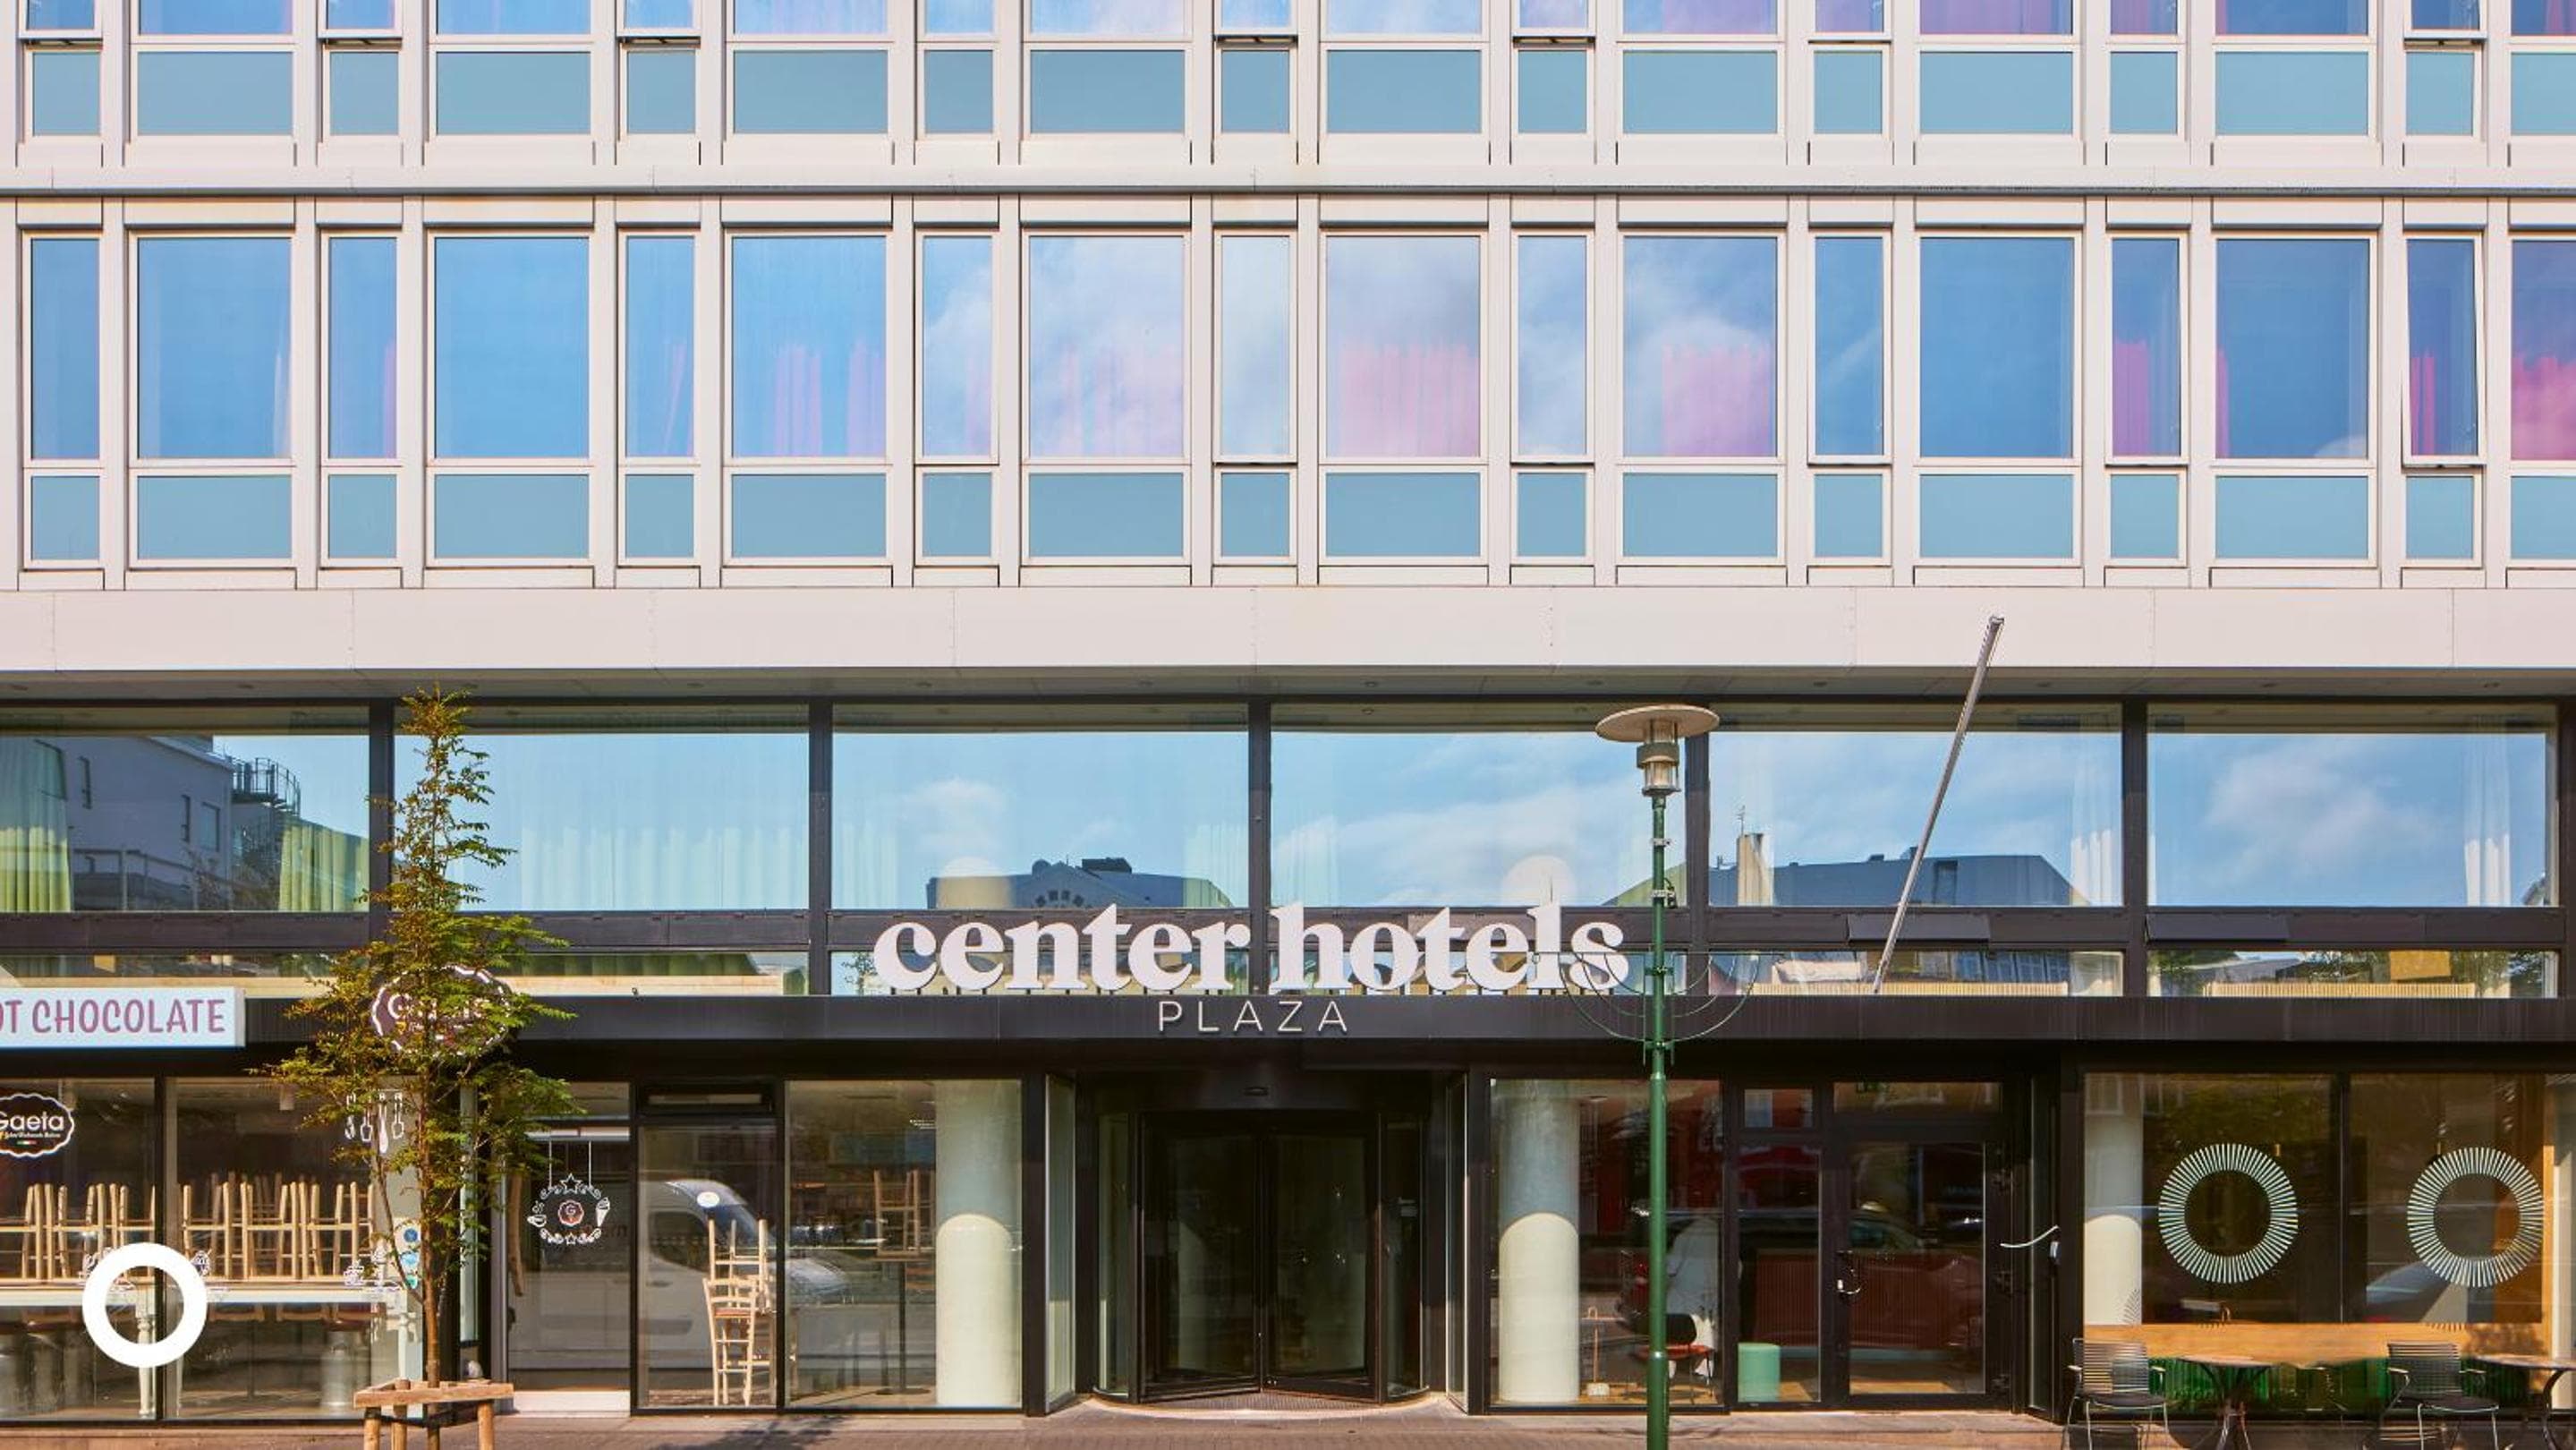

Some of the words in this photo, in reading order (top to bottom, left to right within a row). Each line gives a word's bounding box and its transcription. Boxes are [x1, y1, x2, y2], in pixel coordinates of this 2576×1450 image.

[873, 903, 1252, 992] center
[1269, 900, 1629, 992] hotels
[0, 999, 23, 1034] T
[31, 999, 226, 1034] CHOCOLATE
[1158, 1000, 1348, 1033] PLAZA
